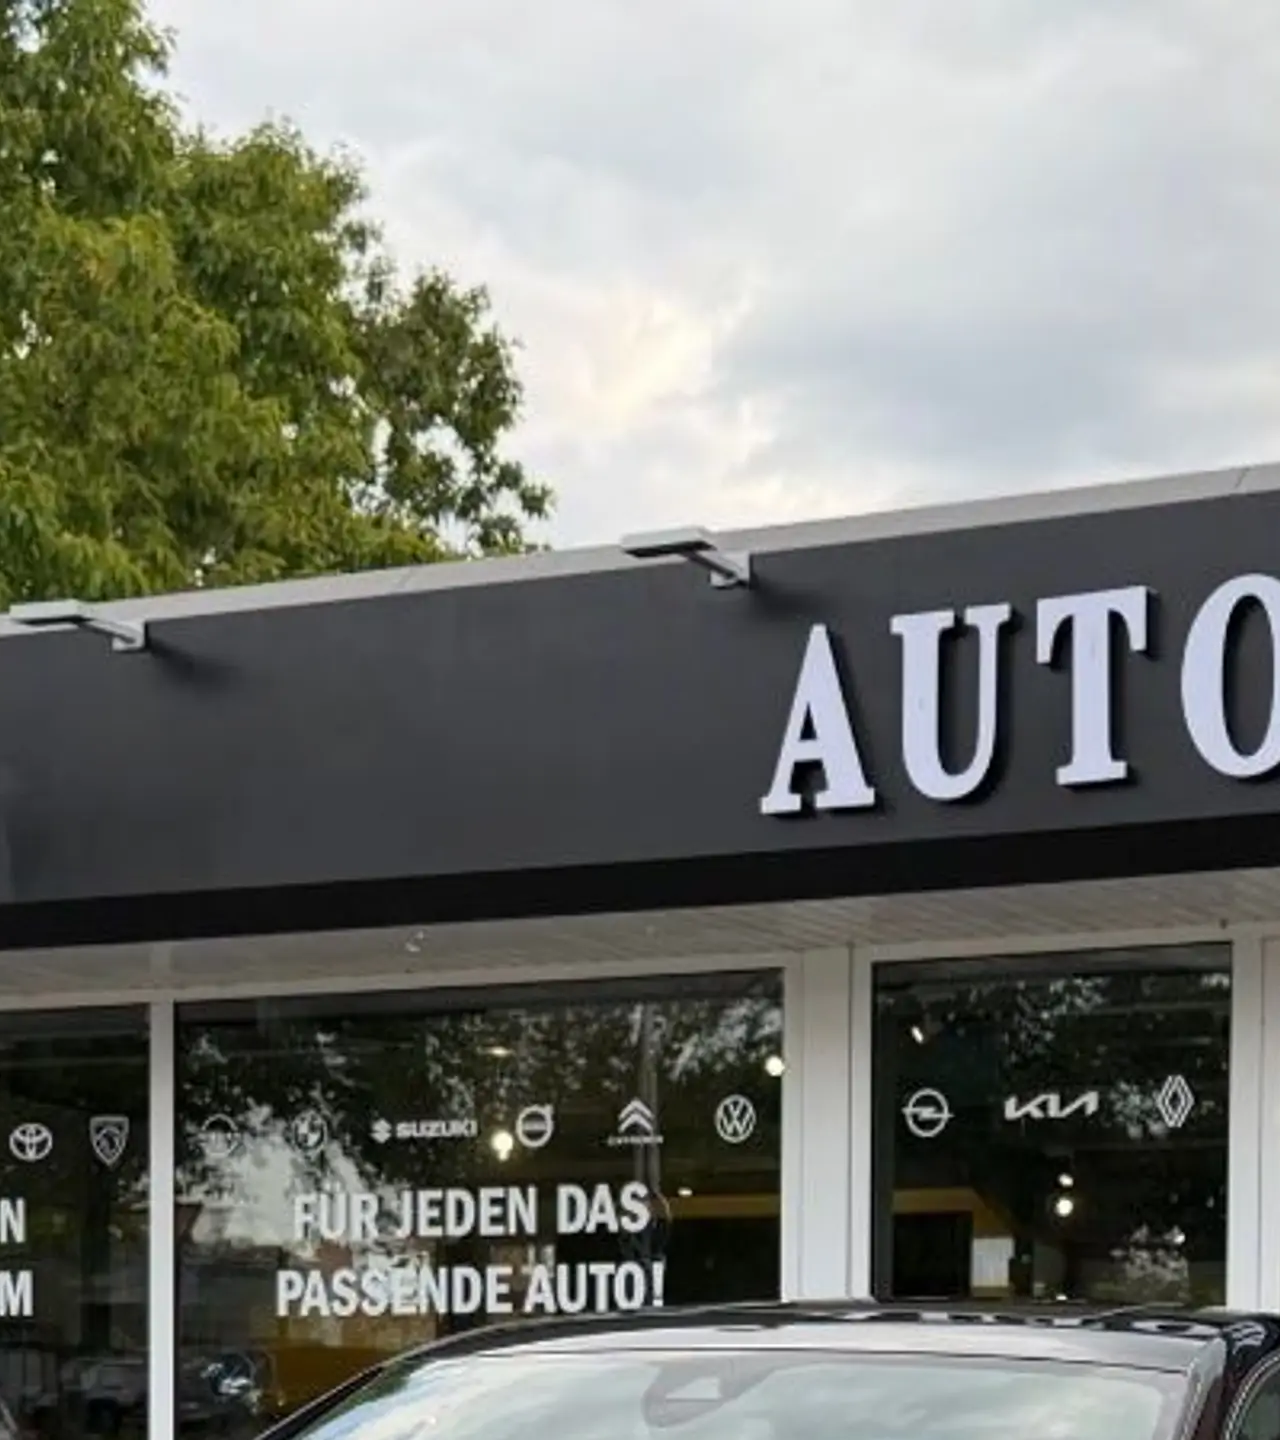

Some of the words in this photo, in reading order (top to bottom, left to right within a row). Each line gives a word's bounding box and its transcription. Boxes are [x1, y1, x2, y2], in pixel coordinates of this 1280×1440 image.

[396, 1119, 478, 1138] SUZUKI
[294, 1182, 379, 1240] FÜR
[396, 1185, 537, 1240] JEDEN
[556, 1182, 652, 1235] DAS
[275, 1265, 513, 1318] PASSENDE
[523, 1261, 666, 1314] AUTO!
